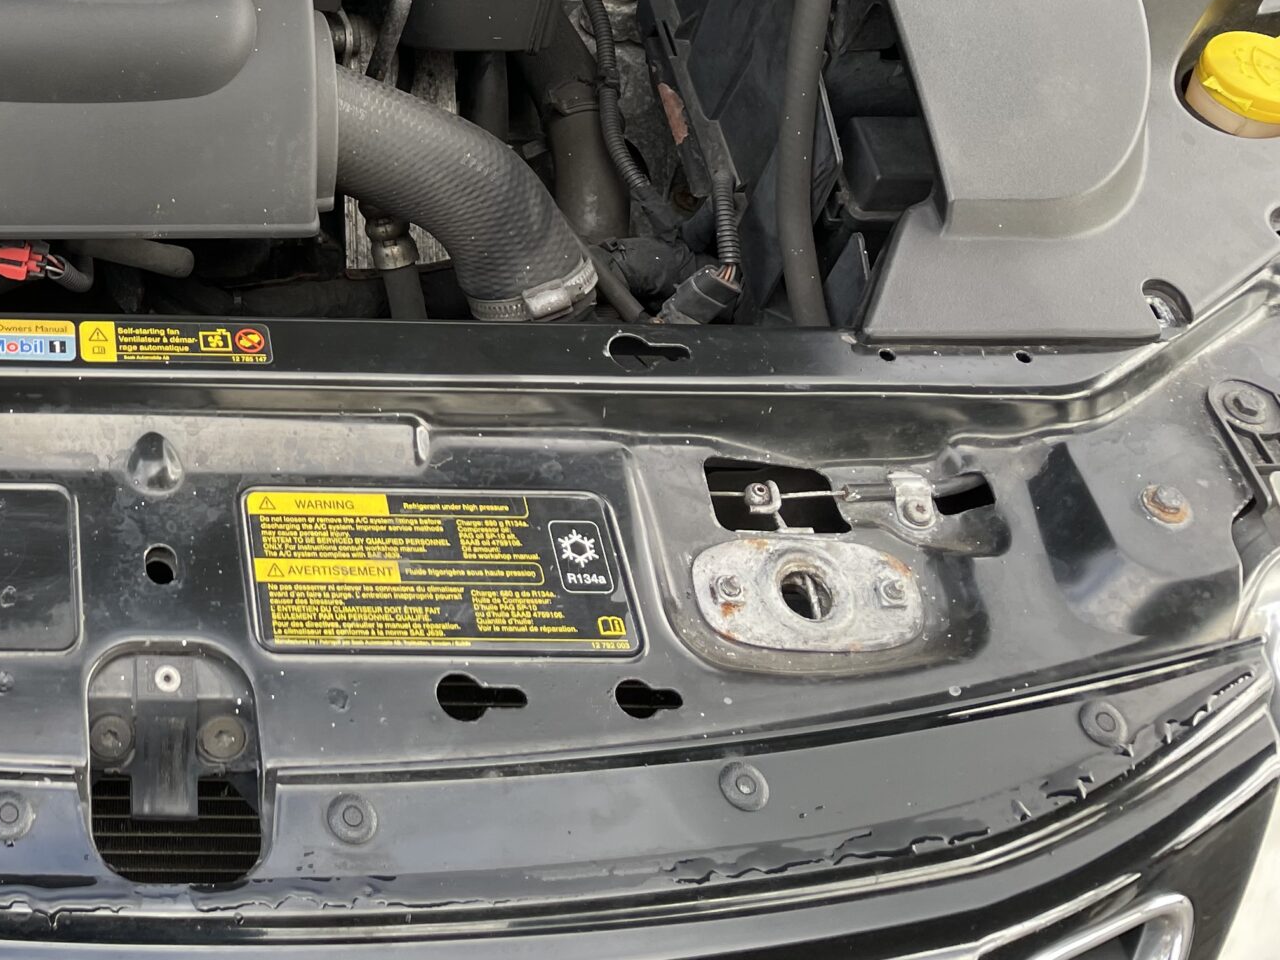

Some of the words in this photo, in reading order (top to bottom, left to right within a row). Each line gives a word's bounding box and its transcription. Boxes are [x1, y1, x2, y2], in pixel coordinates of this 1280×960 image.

[35, 325, 67, 333] Manual
[118, 328, 164, 336] Self-starting
[140, 344, 189, 353] automatique
[295, 500, 354, 510] WARNING
[403, 502, 440, 511] Refrigerant
[463, 504, 478, 512] high
[288, 565, 392, 576] AVERTISSEMENT
[567, 573, 607, 584] R134a
